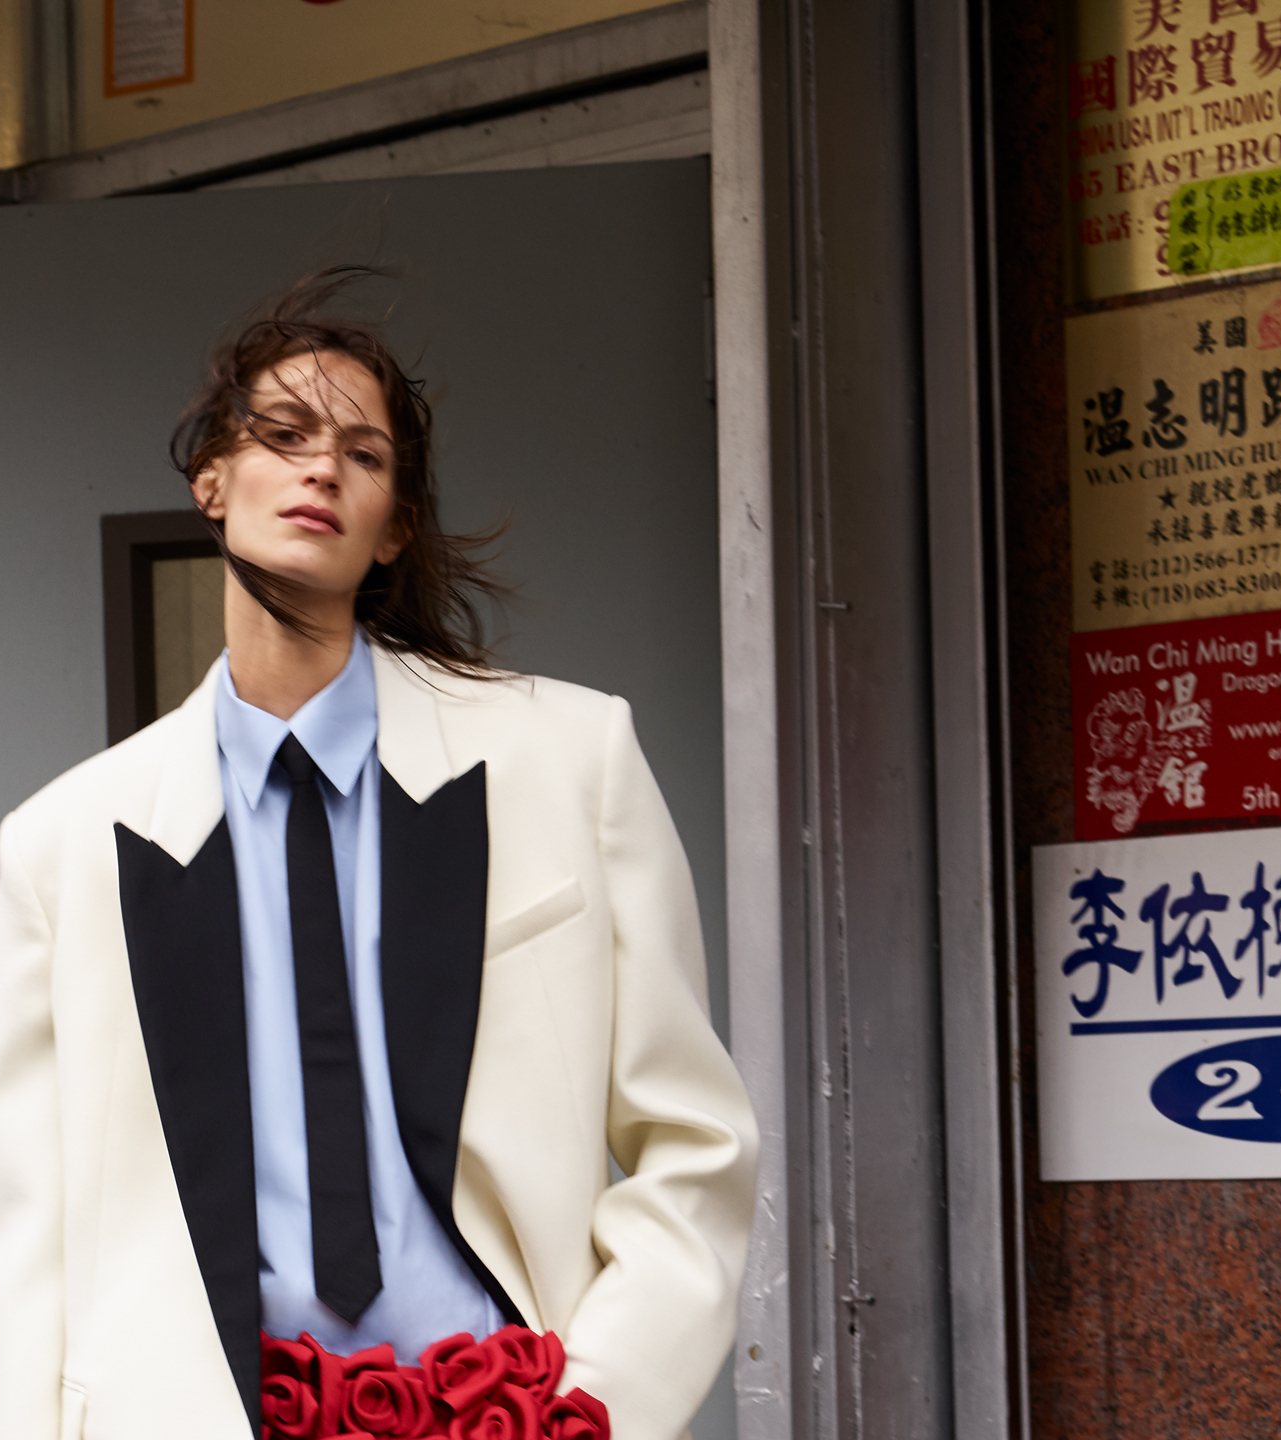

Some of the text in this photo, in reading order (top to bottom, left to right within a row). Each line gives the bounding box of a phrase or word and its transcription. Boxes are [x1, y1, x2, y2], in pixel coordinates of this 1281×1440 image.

[1118, 115, 1154, 150] USA
[1201, 90, 1274, 134] TRADING
[1068, 169, 1104, 202] 65
[1114, 148, 1205, 194] EAST
[1084, 464, 1134, 487] WAN
[1138, 455, 1180, 480] CHI
[1184, 446, 1245, 473] MING
[1086, 649, 1140, 676] Wan
[1146, 638, 1190, 671] Chi
[1196, 632, 1259, 668] Ming
[1241, 782, 1280, 812] 5th
